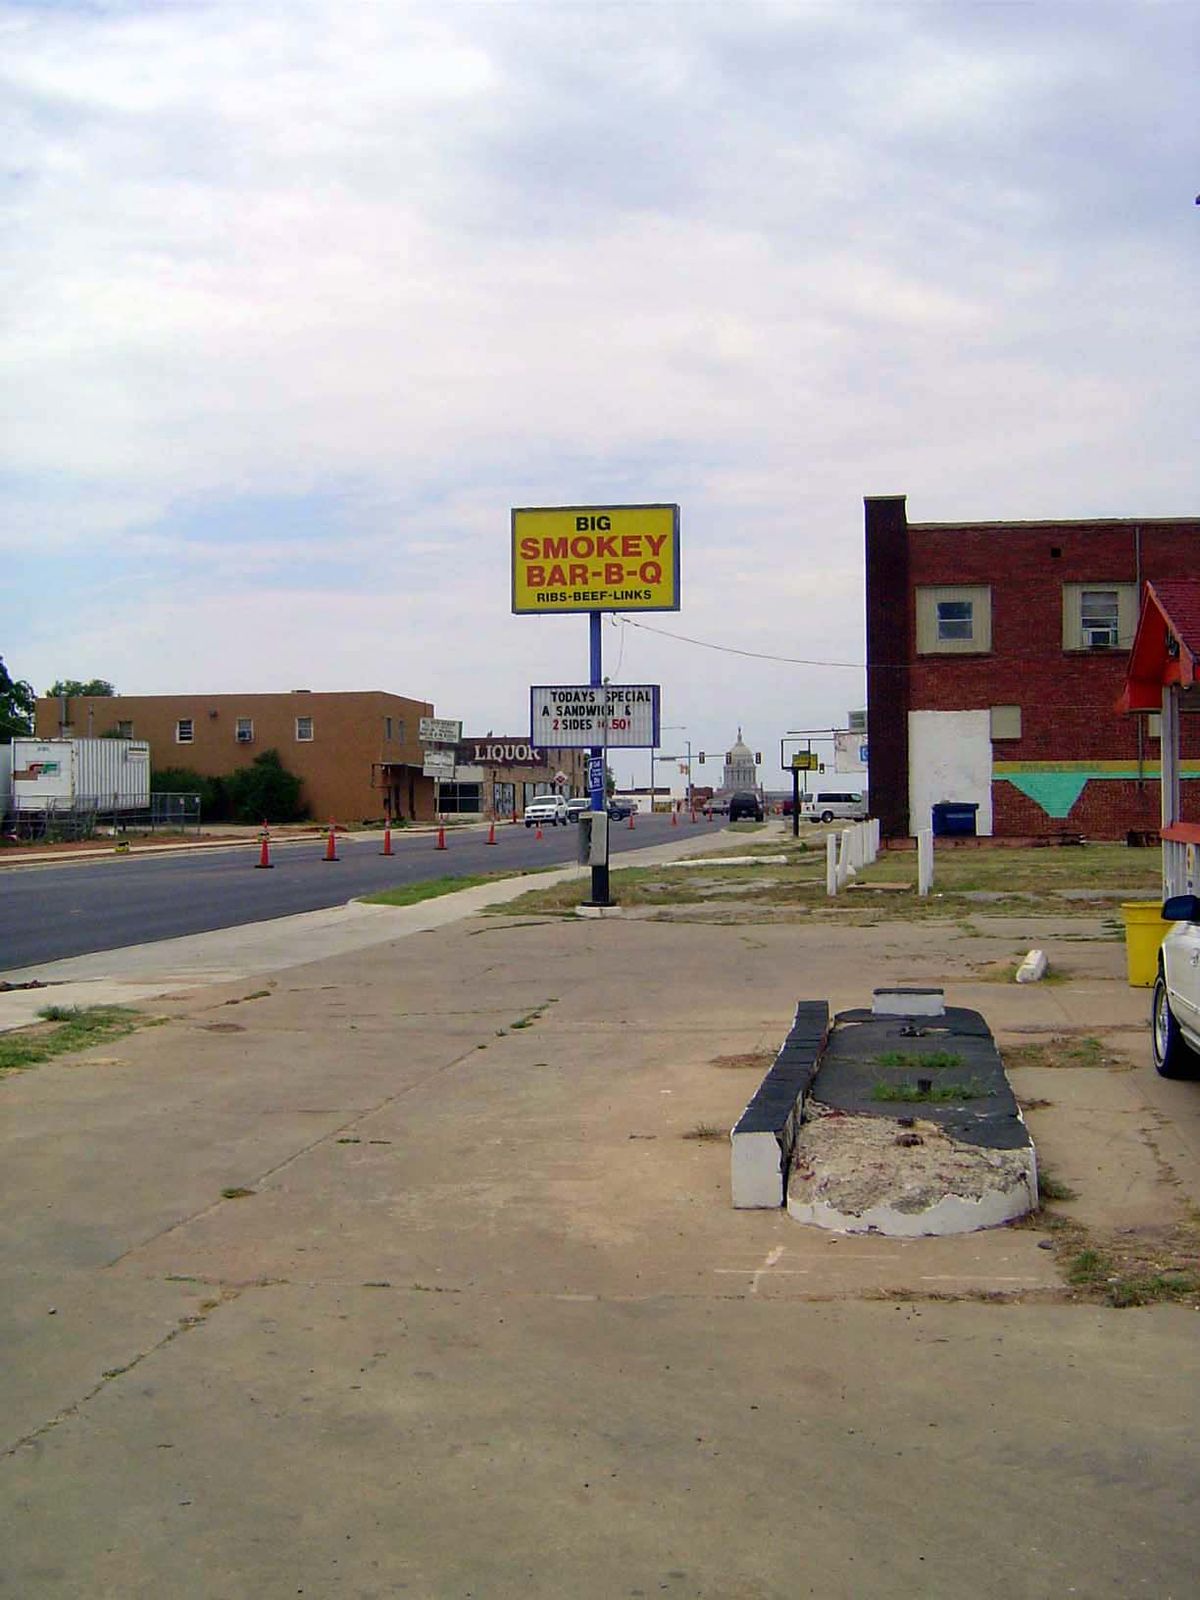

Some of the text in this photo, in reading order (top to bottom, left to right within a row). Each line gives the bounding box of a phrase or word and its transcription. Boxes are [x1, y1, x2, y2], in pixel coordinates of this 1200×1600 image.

[576, 516, 611, 531] BIG
[520, 535, 668, 560] SMOKEY
[526, 561, 662, 587] BAR-B-Q
[537, 590, 652, 603] RIBS-BEEF-LINKS
[550, 690, 651, 702] TODAYS SPECIAL
[542, 705, 550, 716] A
[625, 705, 631, 716] &
[552, 720, 559, 730] 2
[562, 719, 592, 730] SIDES
[474, 745, 541, 762] LIQUOR
